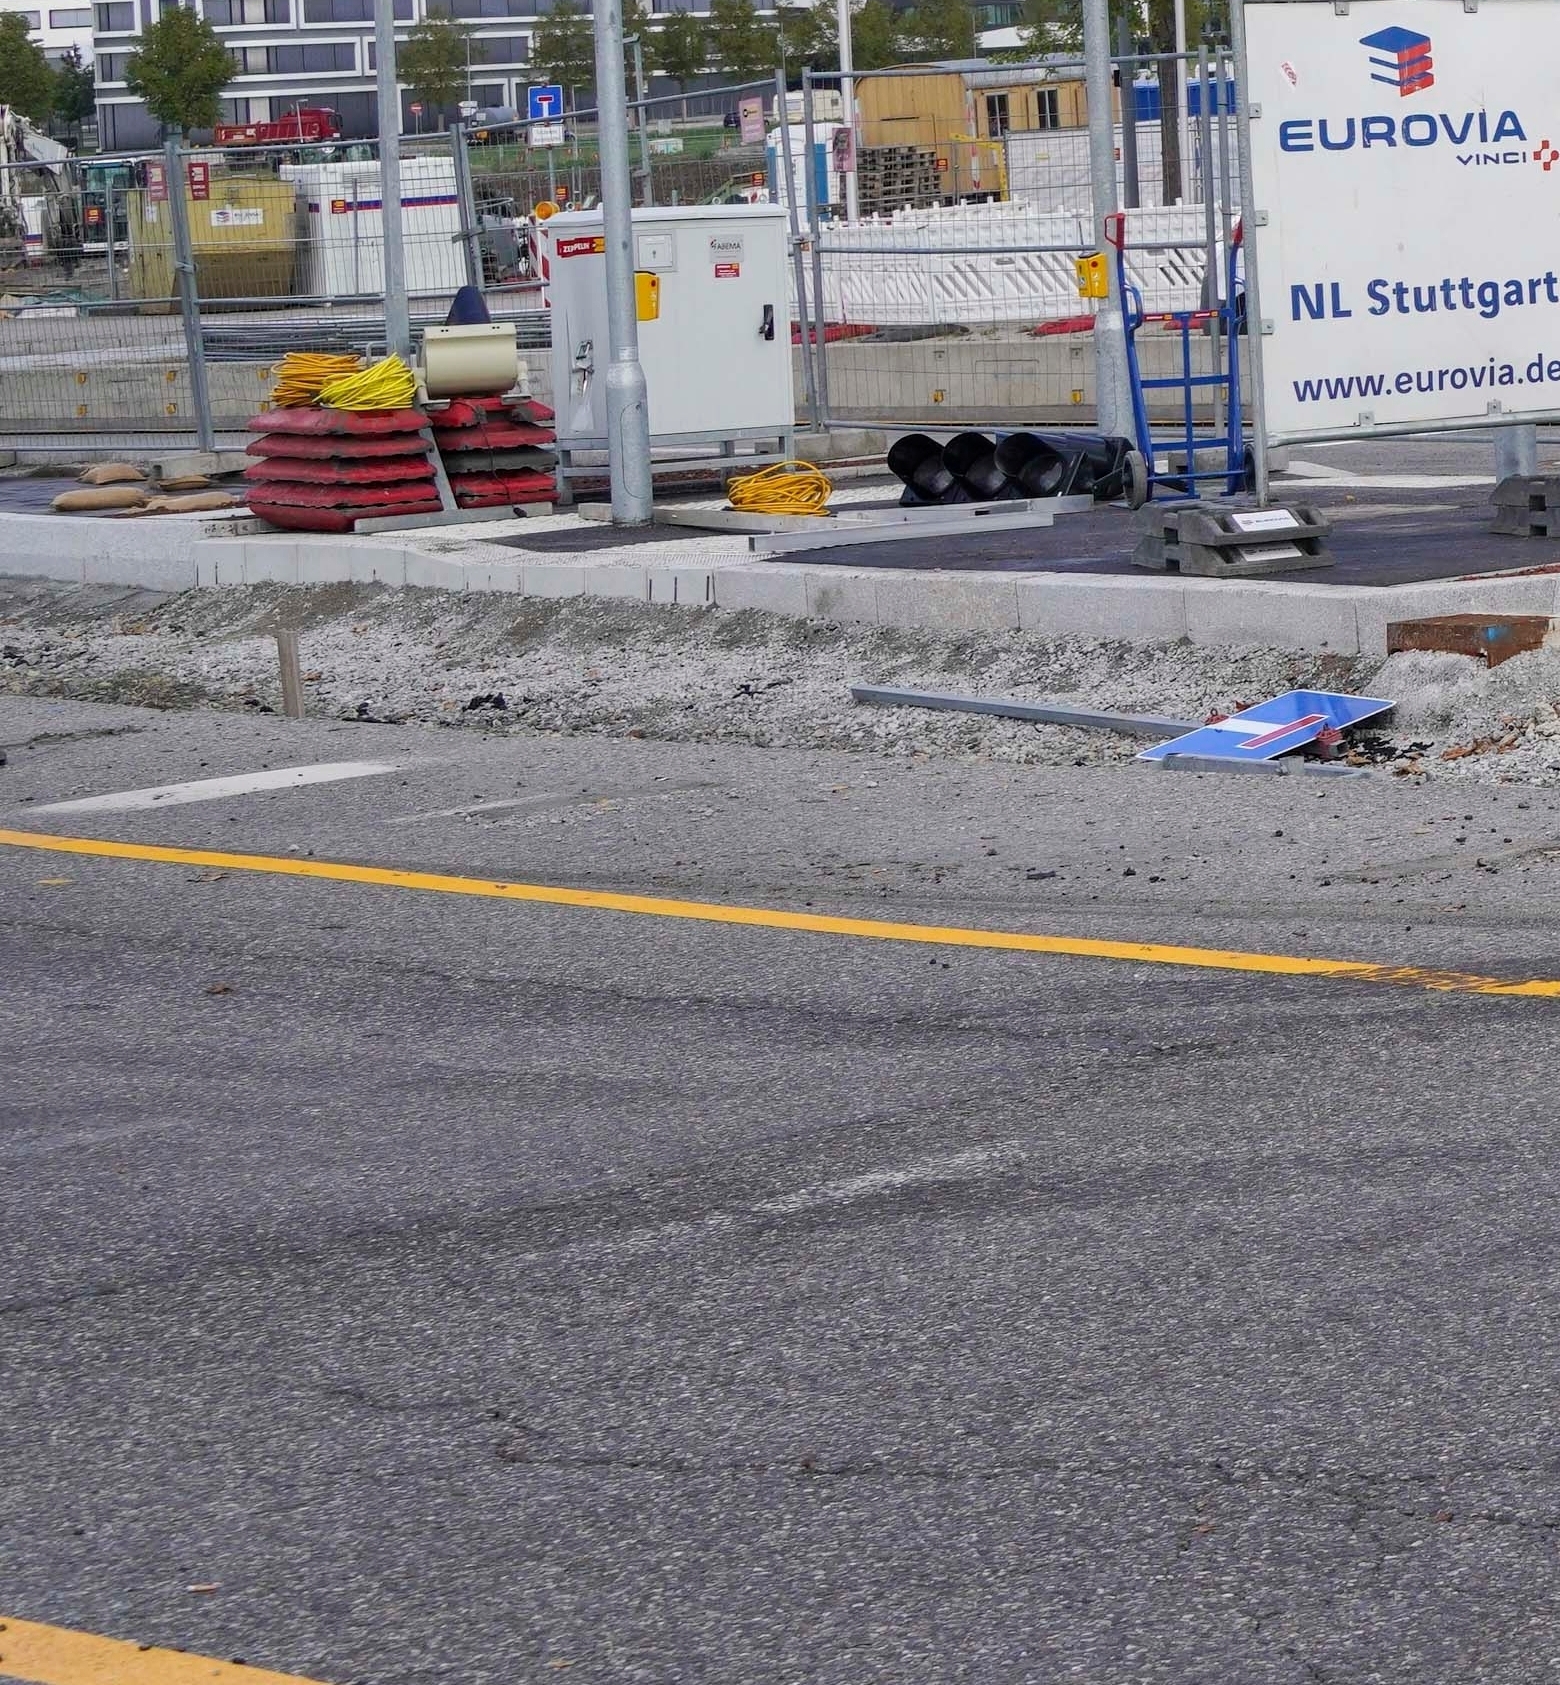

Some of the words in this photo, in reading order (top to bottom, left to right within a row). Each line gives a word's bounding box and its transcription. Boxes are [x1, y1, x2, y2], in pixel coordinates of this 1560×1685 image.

[1279, 109, 1527, 152] EUROVIA
[1456, 151, 1527, 165] VINCI
[562, 242, 590, 253] ZEPPELIN
[1290, 282, 1352, 321] NL
[1367, 271, 1559, 318] Stuttgart
